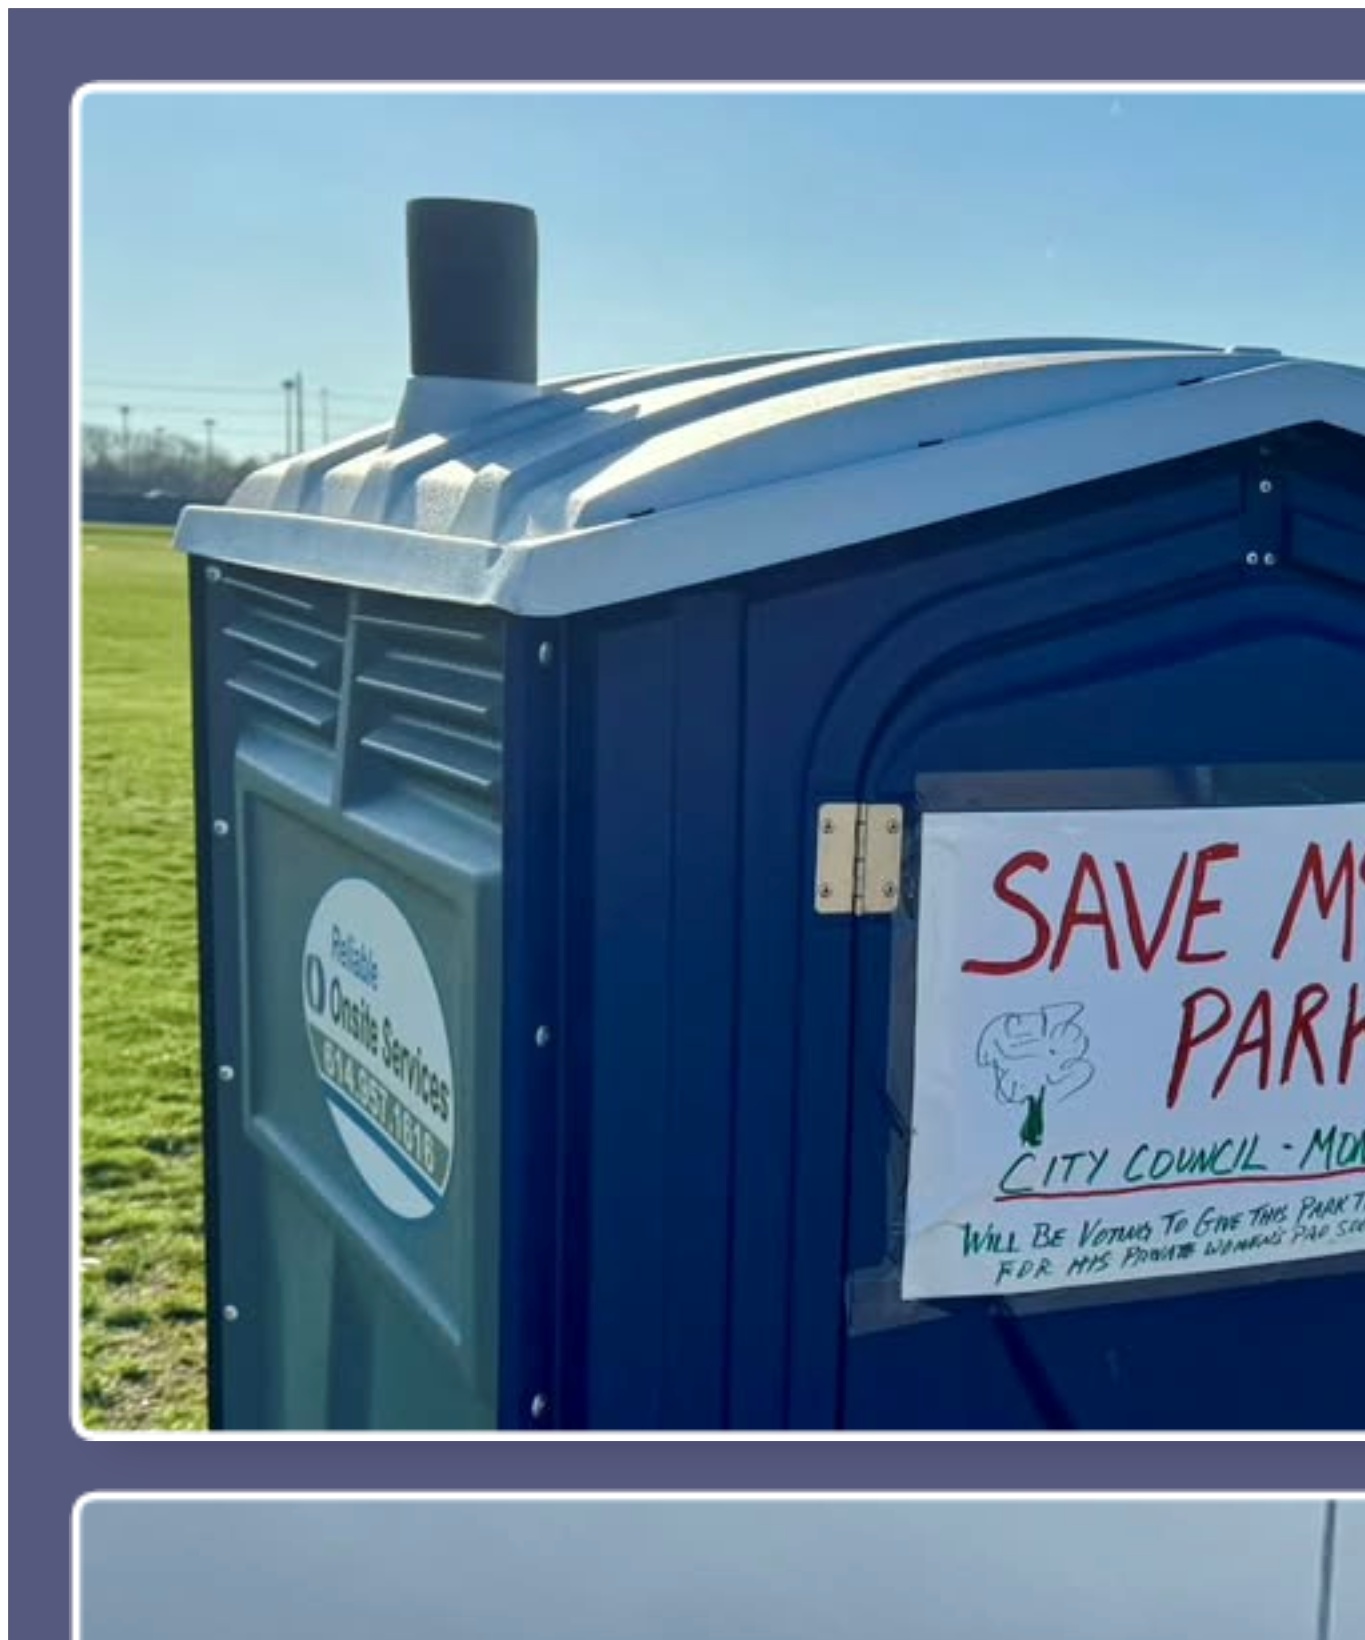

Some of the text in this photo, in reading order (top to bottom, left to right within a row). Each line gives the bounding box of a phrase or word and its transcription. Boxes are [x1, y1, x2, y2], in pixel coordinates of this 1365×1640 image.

[961, 842, 1239, 975] SAVE
[330, 924, 380, 992] Reliable
[330, 976, 450, 1122] Onsite Services
[998, 1148, 1110, 1195] CITY
[1122, 1132, 1268, 1183] COUNCIL
[962, 1211, 1020, 1257] WILL
[1032, 1222, 1066, 1249] BE
[1193, 1204, 1246, 1237] GIVE
[1299, 1195, 1349, 1222] PARK
[995, 1257, 1051, 1285] FOR
